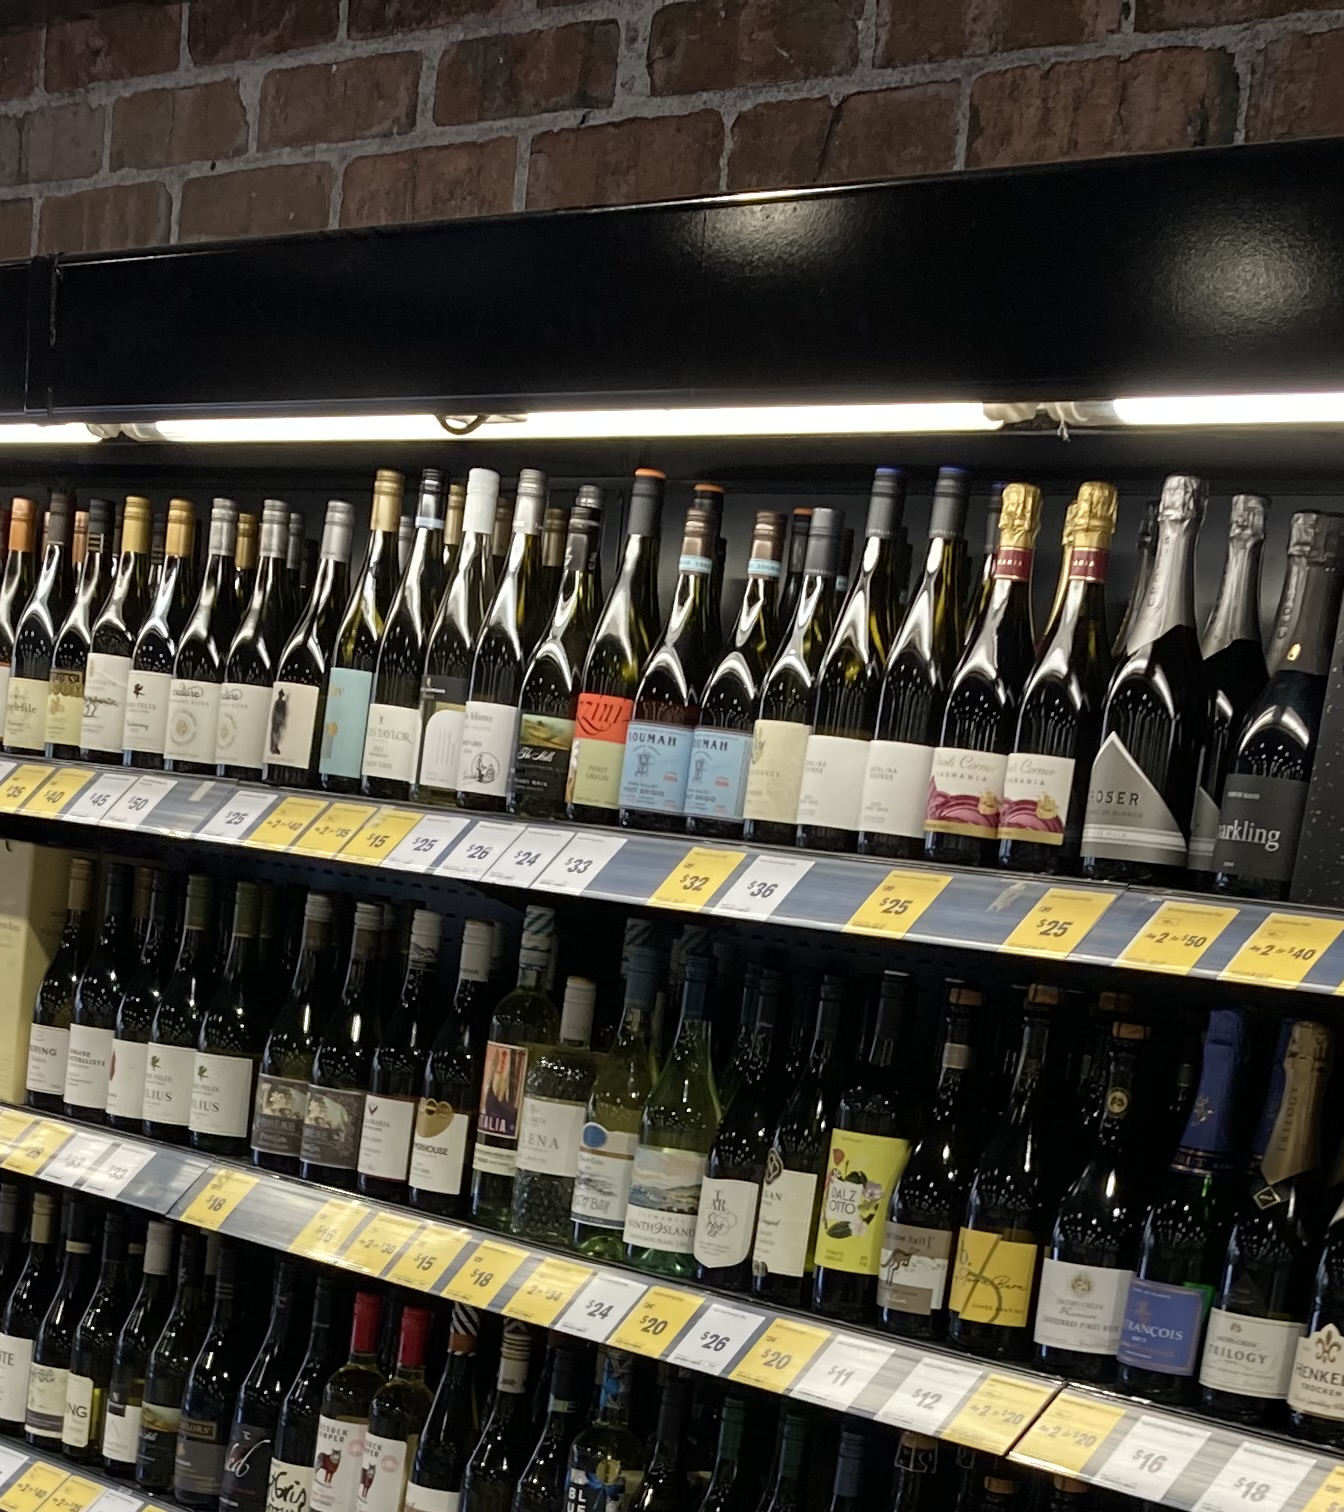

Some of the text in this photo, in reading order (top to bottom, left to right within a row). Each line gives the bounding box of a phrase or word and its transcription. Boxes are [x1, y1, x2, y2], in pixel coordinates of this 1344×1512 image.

[878, 896, 914, 916] $25
[1037, 918, 1074, 938] $25
[586, 1300, 612, 1321] $24
[639, 1314, 667, 1336] $20
[701, 1331, 730, 1352] $26
